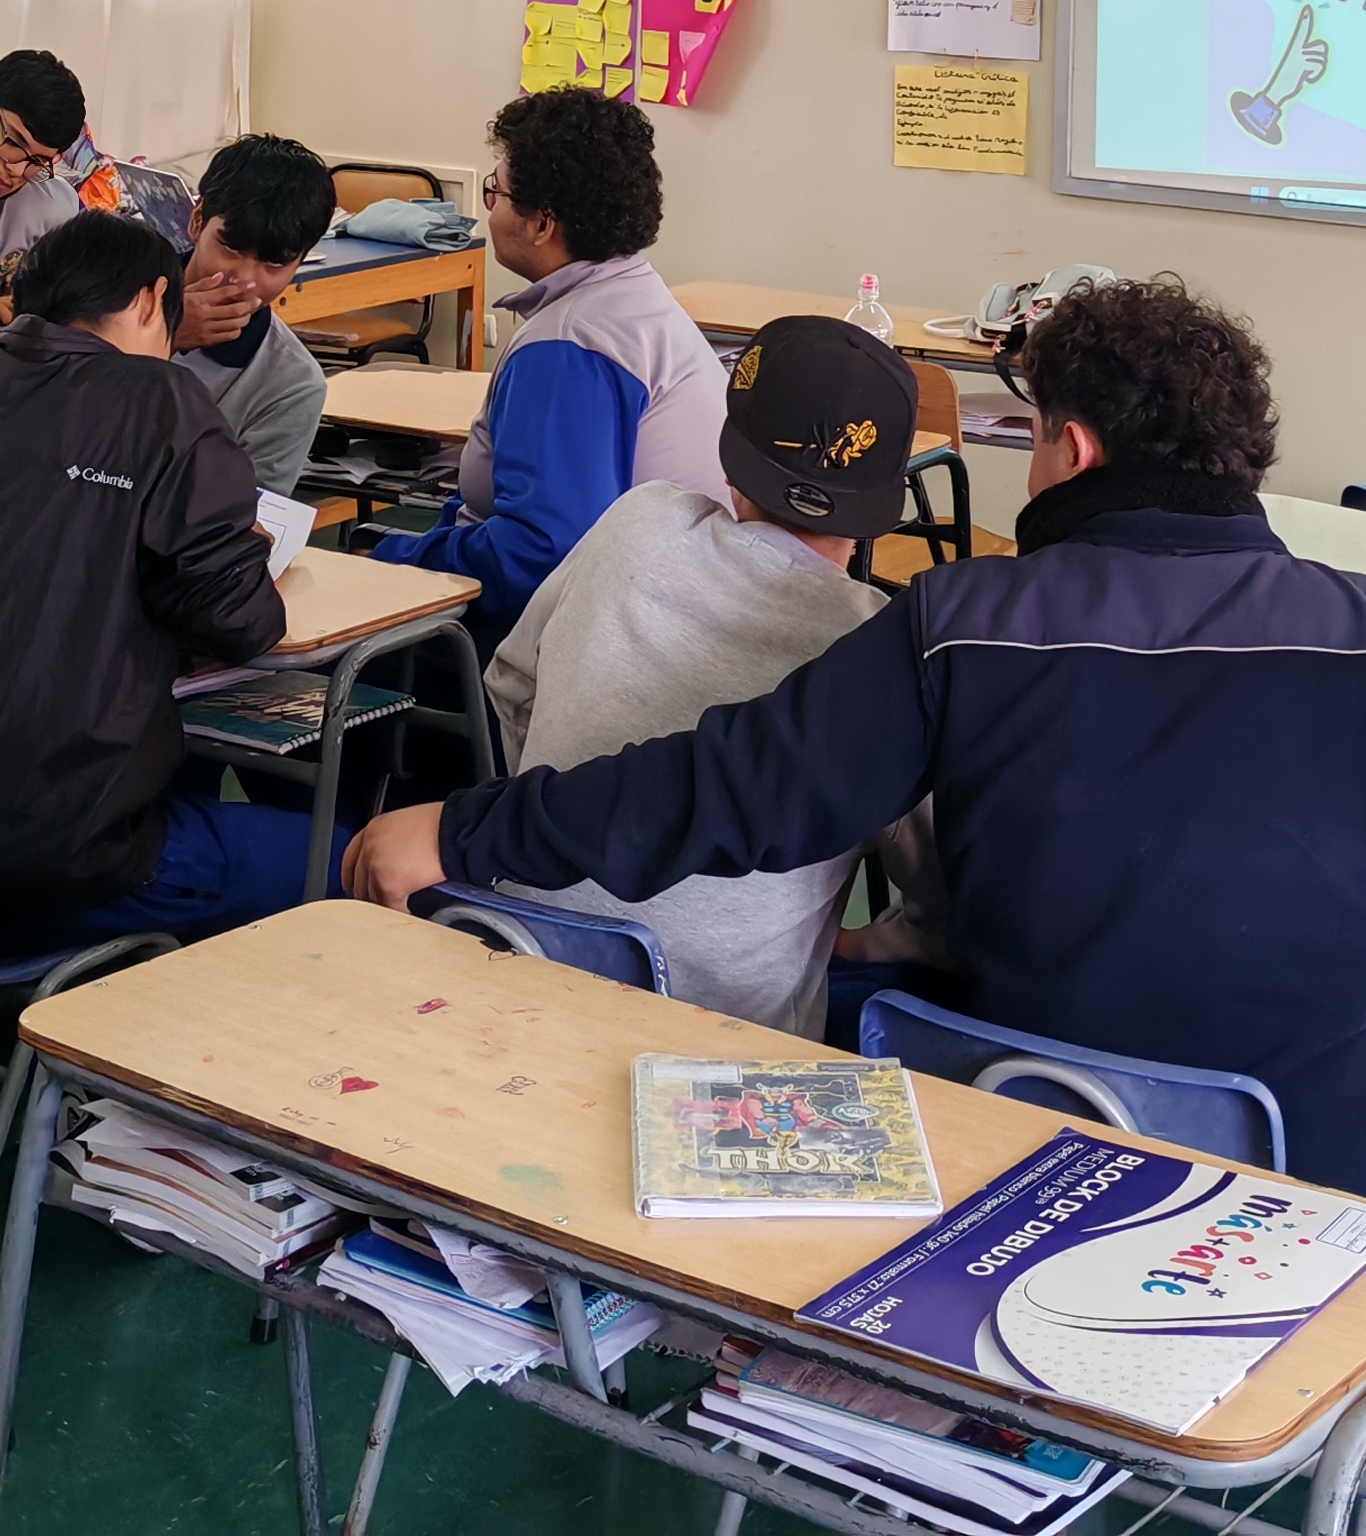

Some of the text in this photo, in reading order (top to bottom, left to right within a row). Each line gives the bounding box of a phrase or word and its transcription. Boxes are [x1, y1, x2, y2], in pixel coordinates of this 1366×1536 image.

[82, 467, 133, 490] Columbia
[703, 1147, 875, 1175] THOR
[1057, 1141, 1085, 1161] Papel
[1050, 1147, 1116, 1188] MEDIUM
[966, 1153, 1146, 1276] BLOCK DE DIBUJO
[984, 1192, 1010, 1214] Papel
[821, 1305, 843, 1318] cm
[850, 1296, 904, 1330] HOJAS
[866, 1319, 892, 1335] 20
